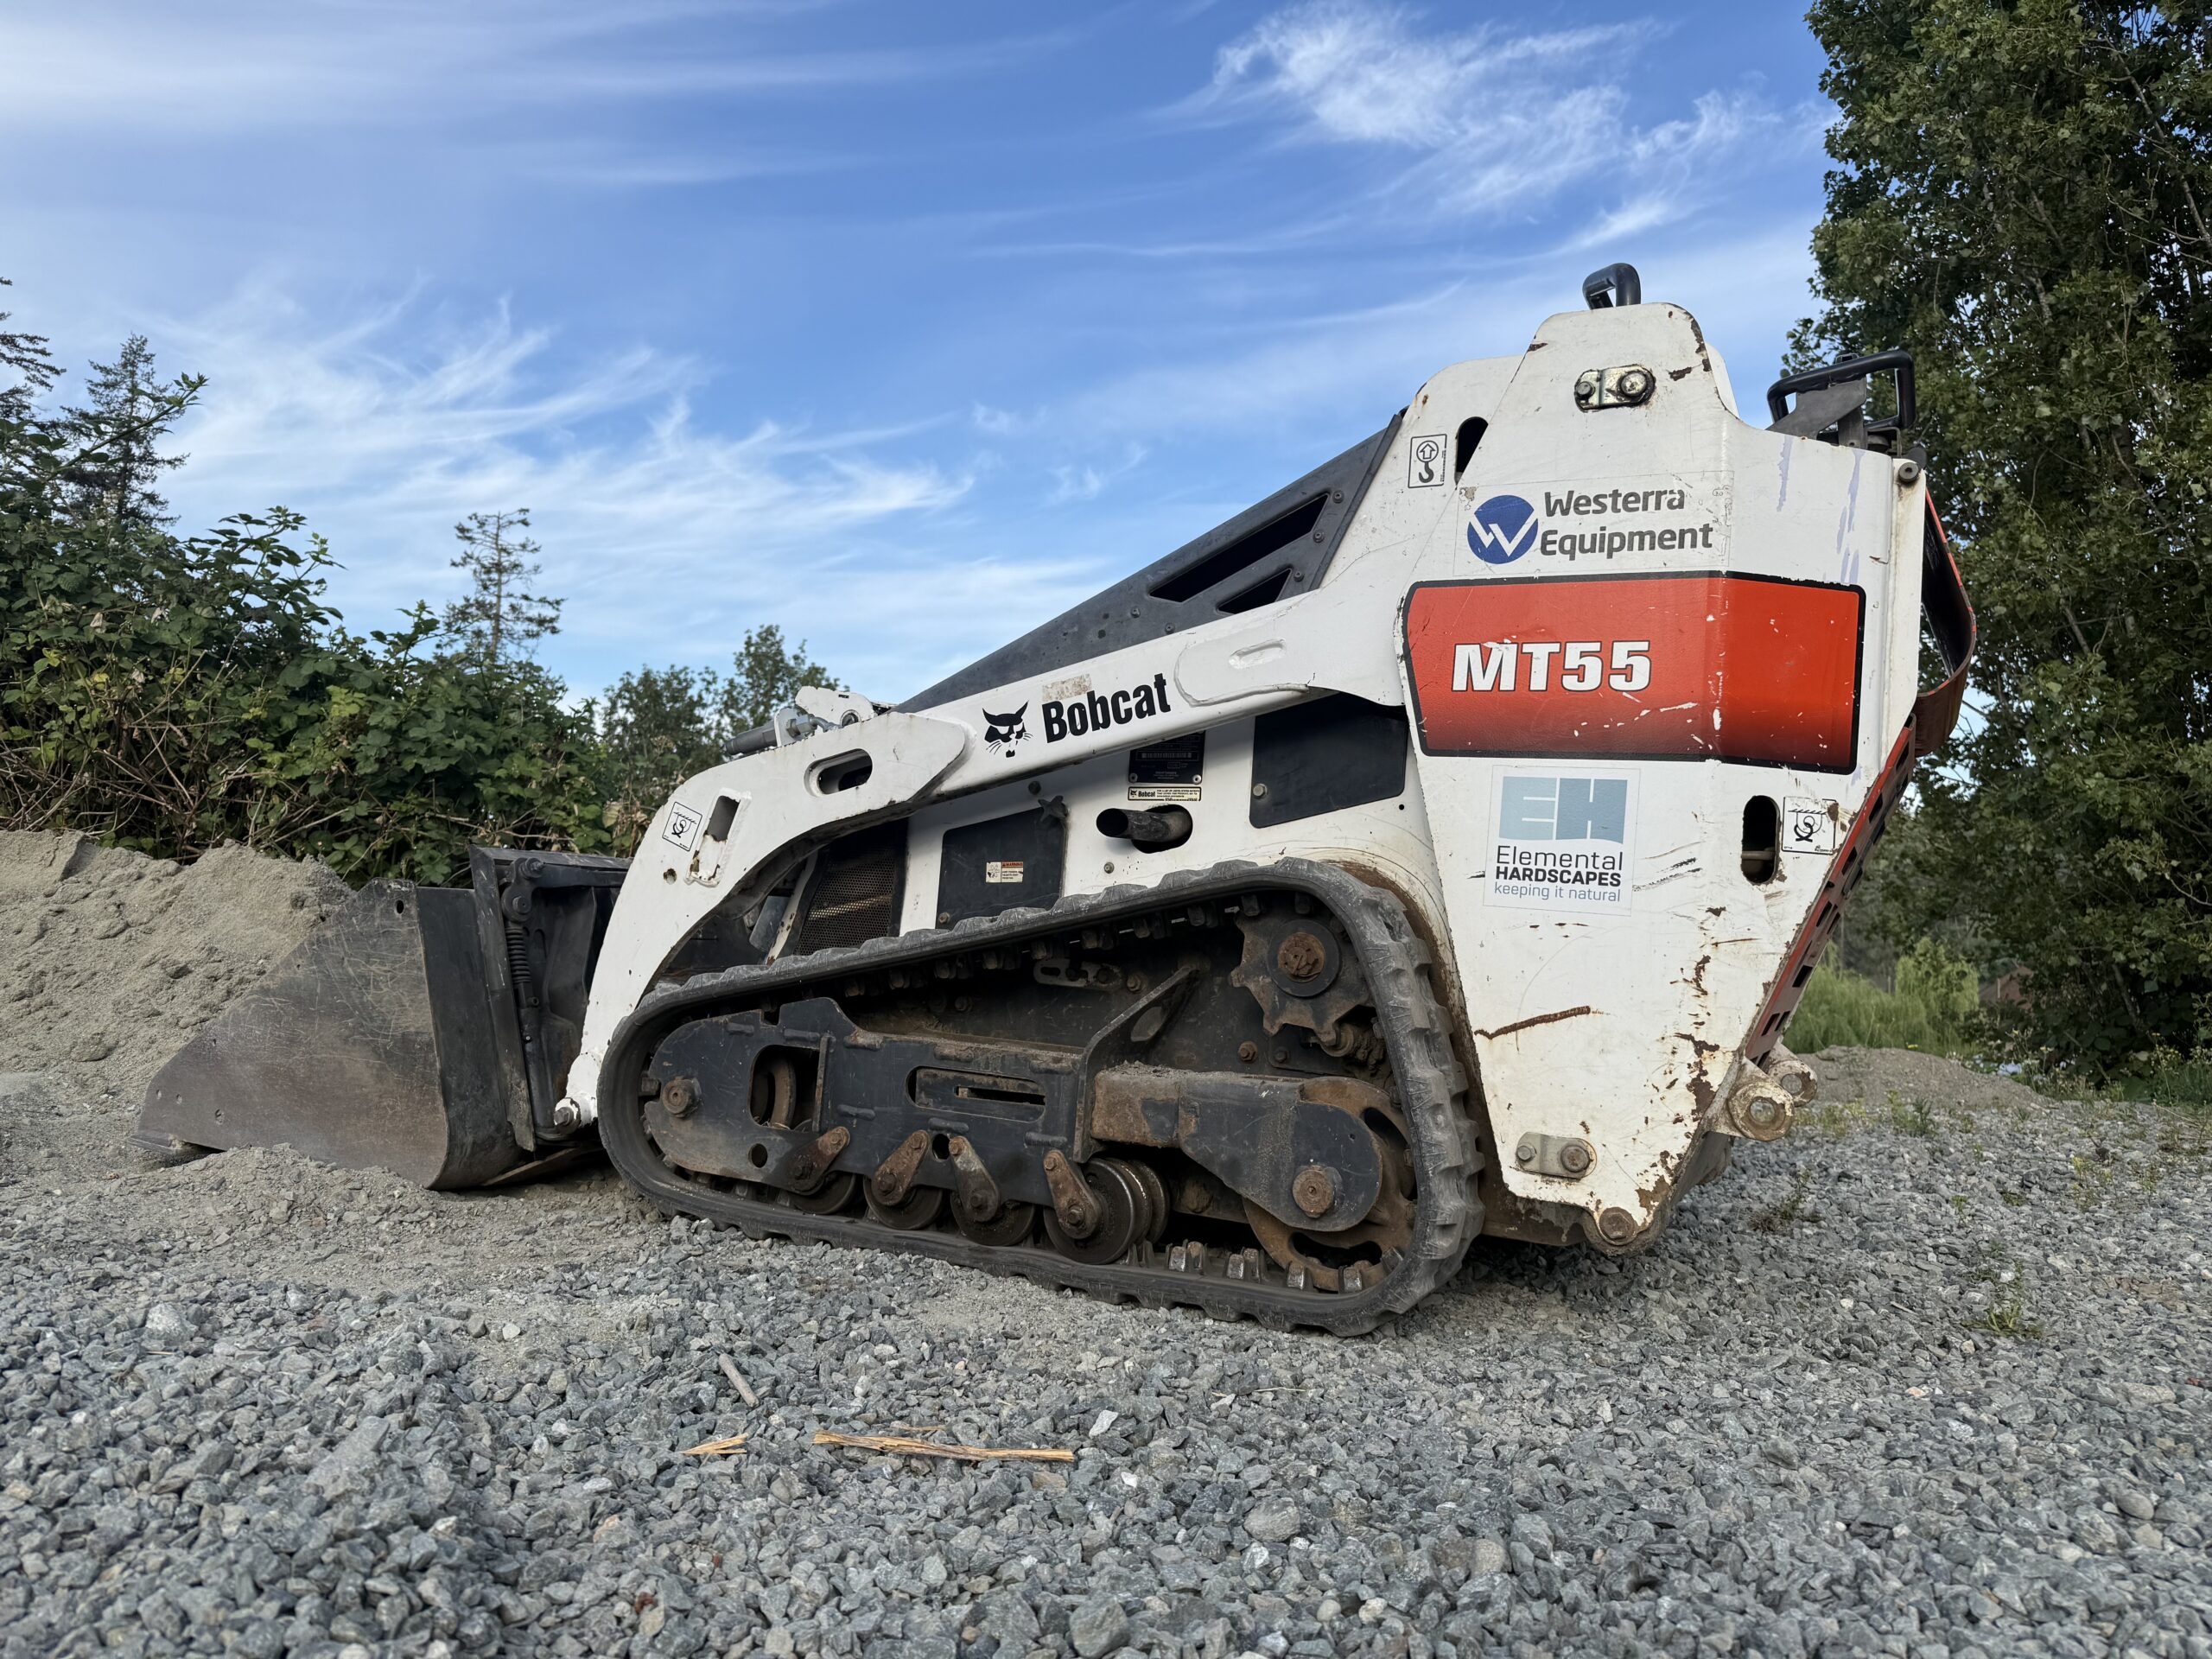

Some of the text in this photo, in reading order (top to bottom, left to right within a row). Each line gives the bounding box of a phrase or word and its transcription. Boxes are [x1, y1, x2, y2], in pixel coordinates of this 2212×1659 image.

[1544, 489, 1685, 518] Westerra
[1540, 524, 1713, 561] Equipment
[1452, 640, 1651, 692] MT55
[1042, 673, 1172, 743] Bobcat
[1497, 845, 1623, 870] Elemental
[1496, 866, 1621, 887] HARDSCAPES
[1494, 881, 1621, 902] keeping it natural
